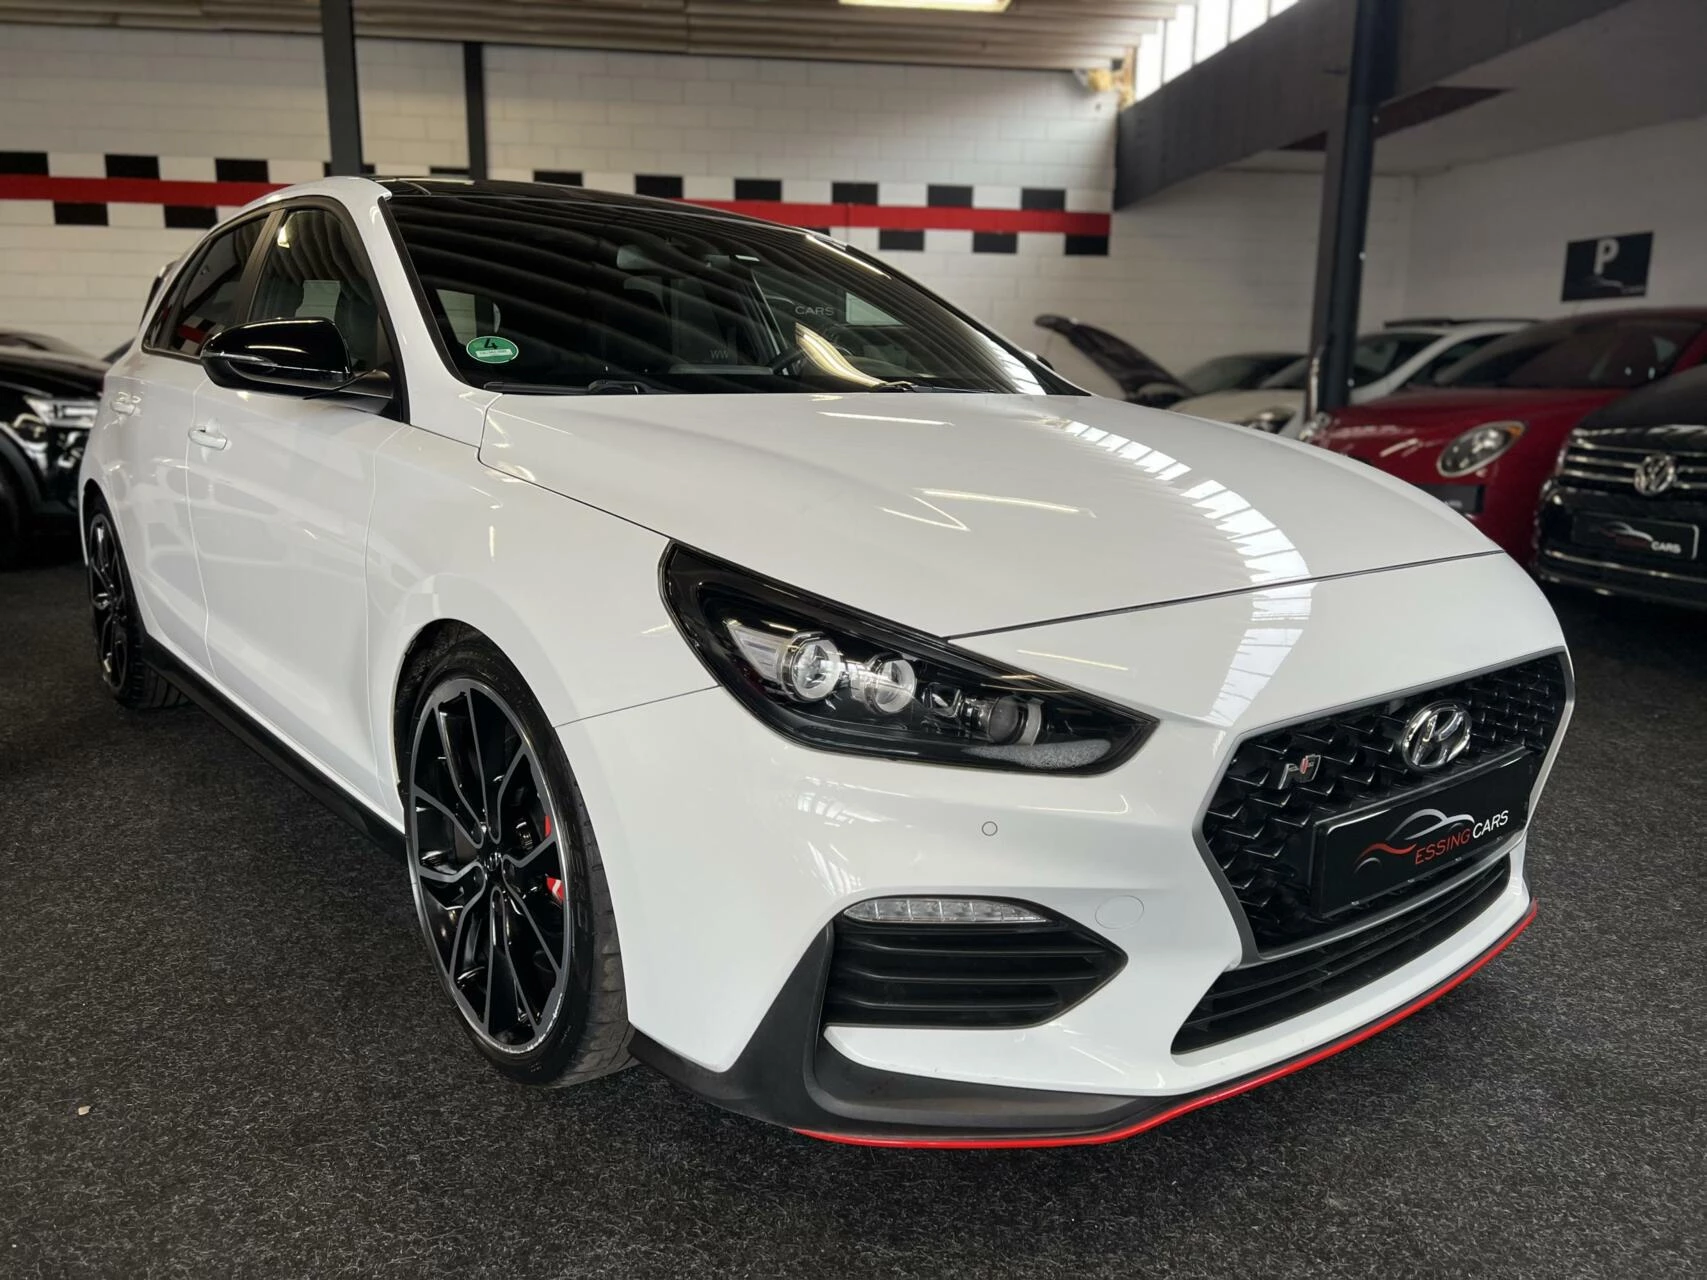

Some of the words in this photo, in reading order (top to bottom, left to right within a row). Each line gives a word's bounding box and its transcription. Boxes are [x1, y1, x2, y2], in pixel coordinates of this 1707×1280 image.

[1594, 239, 1619, 275] P
[794, 305, 835, 317] CARS
[483, 338, 498, 349] 4
[1651, 541, 1682, 554] CARS
[1415, 828, 1472, 865] ESSING
[1472, 810, 1509, 839] CARS
